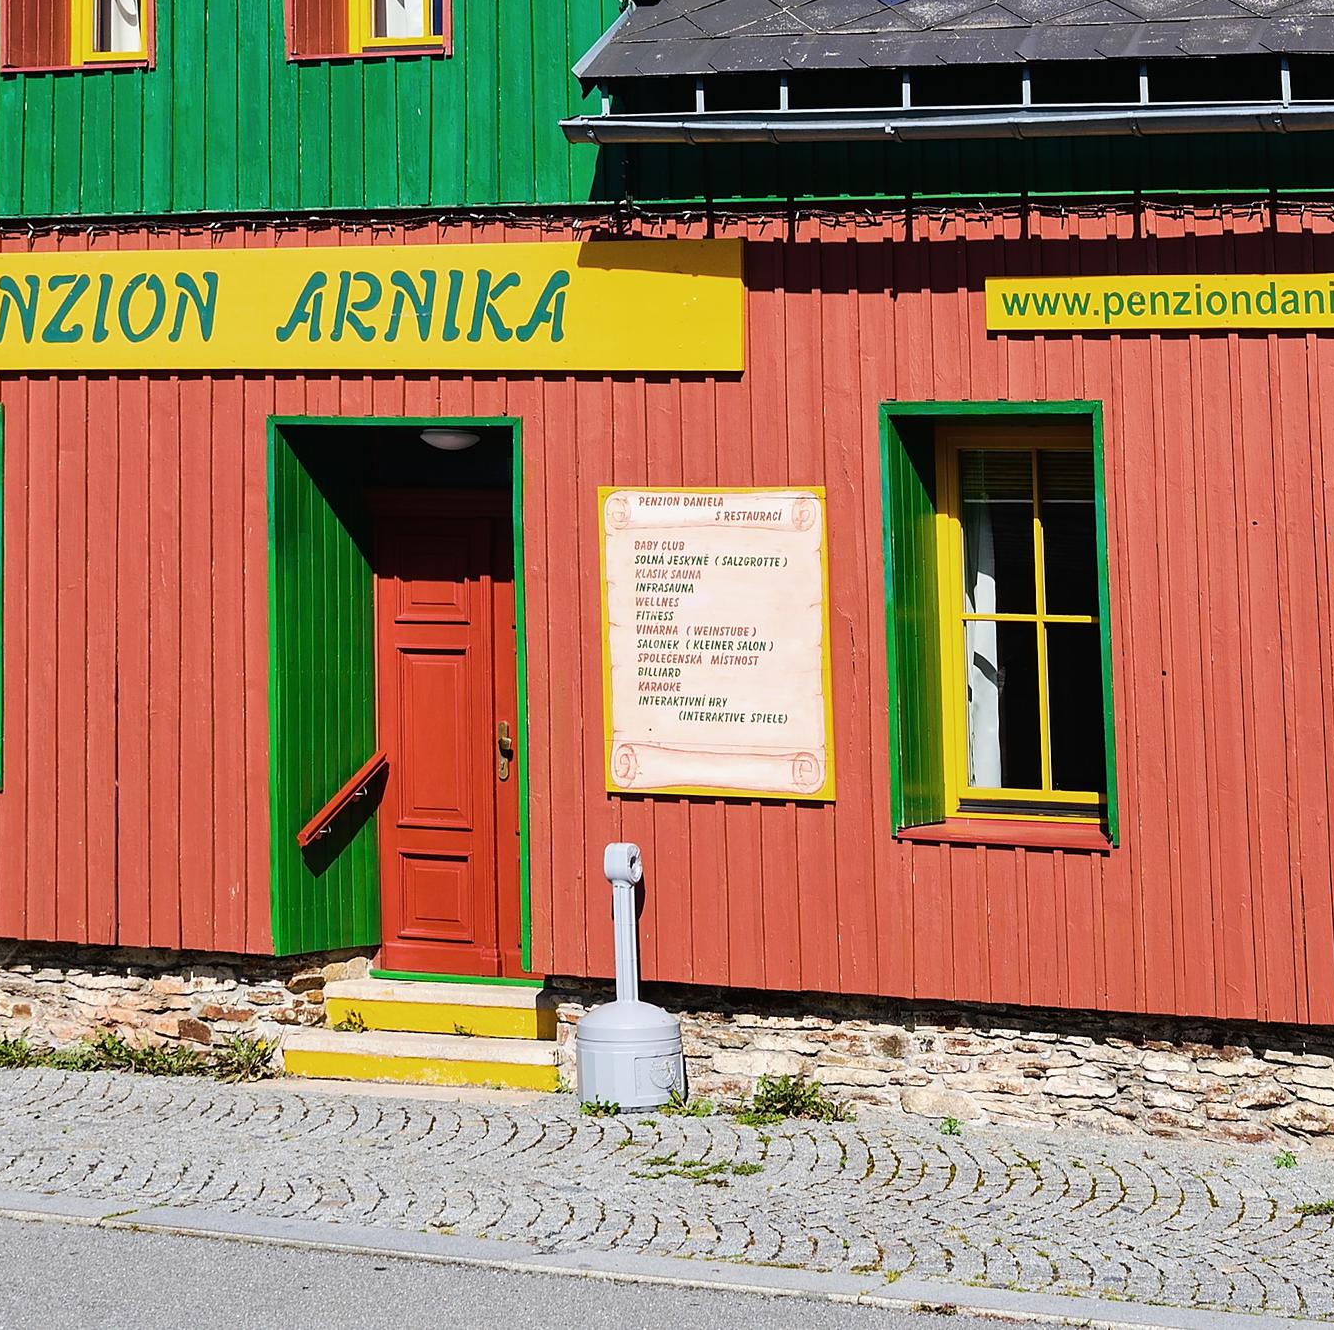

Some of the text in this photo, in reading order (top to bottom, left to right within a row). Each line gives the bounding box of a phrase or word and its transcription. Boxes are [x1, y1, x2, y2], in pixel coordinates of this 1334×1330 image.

[275, 268, 570, 343] ARNIKA
[639, 496, 724, 507] PENZION DANIELA
[715, 508, 782, 522] S RESTAURACÍ
[634, 540, 685, 551] BABY CLUB
[634, 552, 664, 566] SOLNÁ
[635, 569, 702, 580] KLASIK SAUNA
[635, 583, 694, 593] INFRASAUNA
[635, 597, 680, 607] WELLNES
[636, 611, 675, 621] FITNESS
[636, 622, 679, 636] VINÁRNA
[637, 639, 680, 650] SALONEK
[637, 651, 760, 666] SPOLEČENSKÁ MÍSTNOST
[637, 667, 682, 678] BILLIARD
[638, 681, 682, 692] KARAOKE
[638, 694, 728, 707] INTERAKTIVNÍ HRY
[678, 710, 788, 724] (INTERAKTIVE SPIELE)
